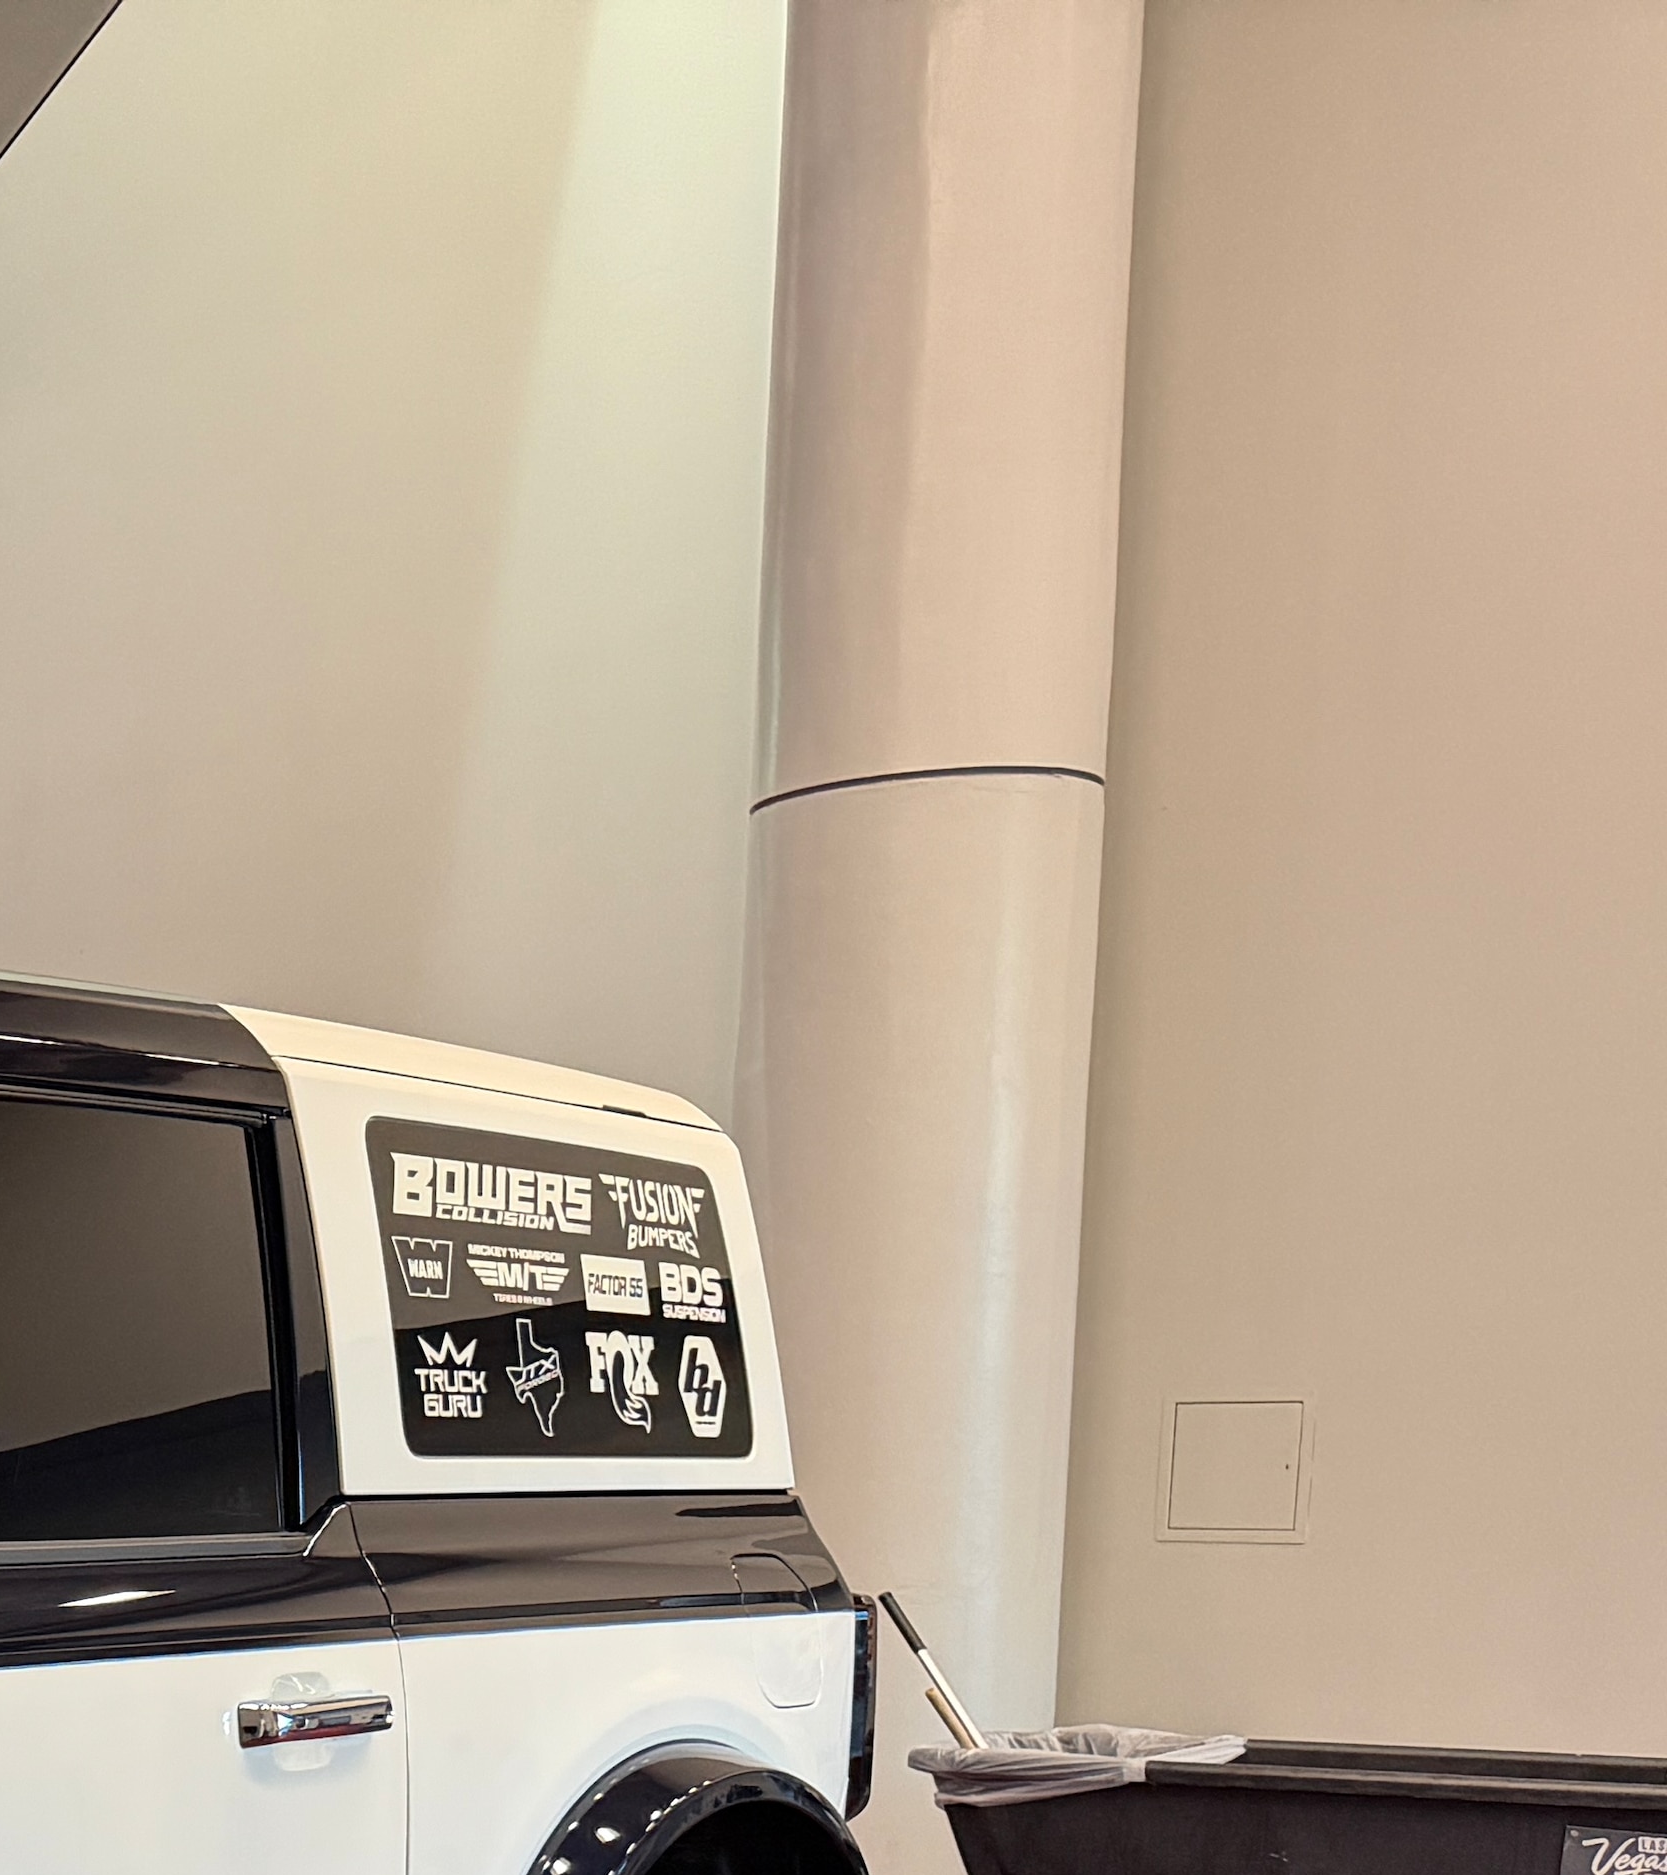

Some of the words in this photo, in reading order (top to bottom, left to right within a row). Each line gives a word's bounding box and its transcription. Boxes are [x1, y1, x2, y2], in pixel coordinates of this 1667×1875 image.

[390, 1152, 592, 1235] BOWERS
[599, 1174, 705, 1239] FUSION
[436, 1203, 555, 1231] COLLISION
[627, 1224, 701, 1259] BUMPERS
[407, 1258, 443, 1280] WARN
[588, 1273, 627, 1297] FACTOR
[629, 1277, 644, 1298] 55
[658, 1261, 723, 1307] BDS
[662, 1303, 727, 1323] SUSPENSION
[414, 1368, 488, 1394] TRUCK
[423, 1393, 483, 1419] GURU
[1641, 1839, 1666, 1851] LAS
